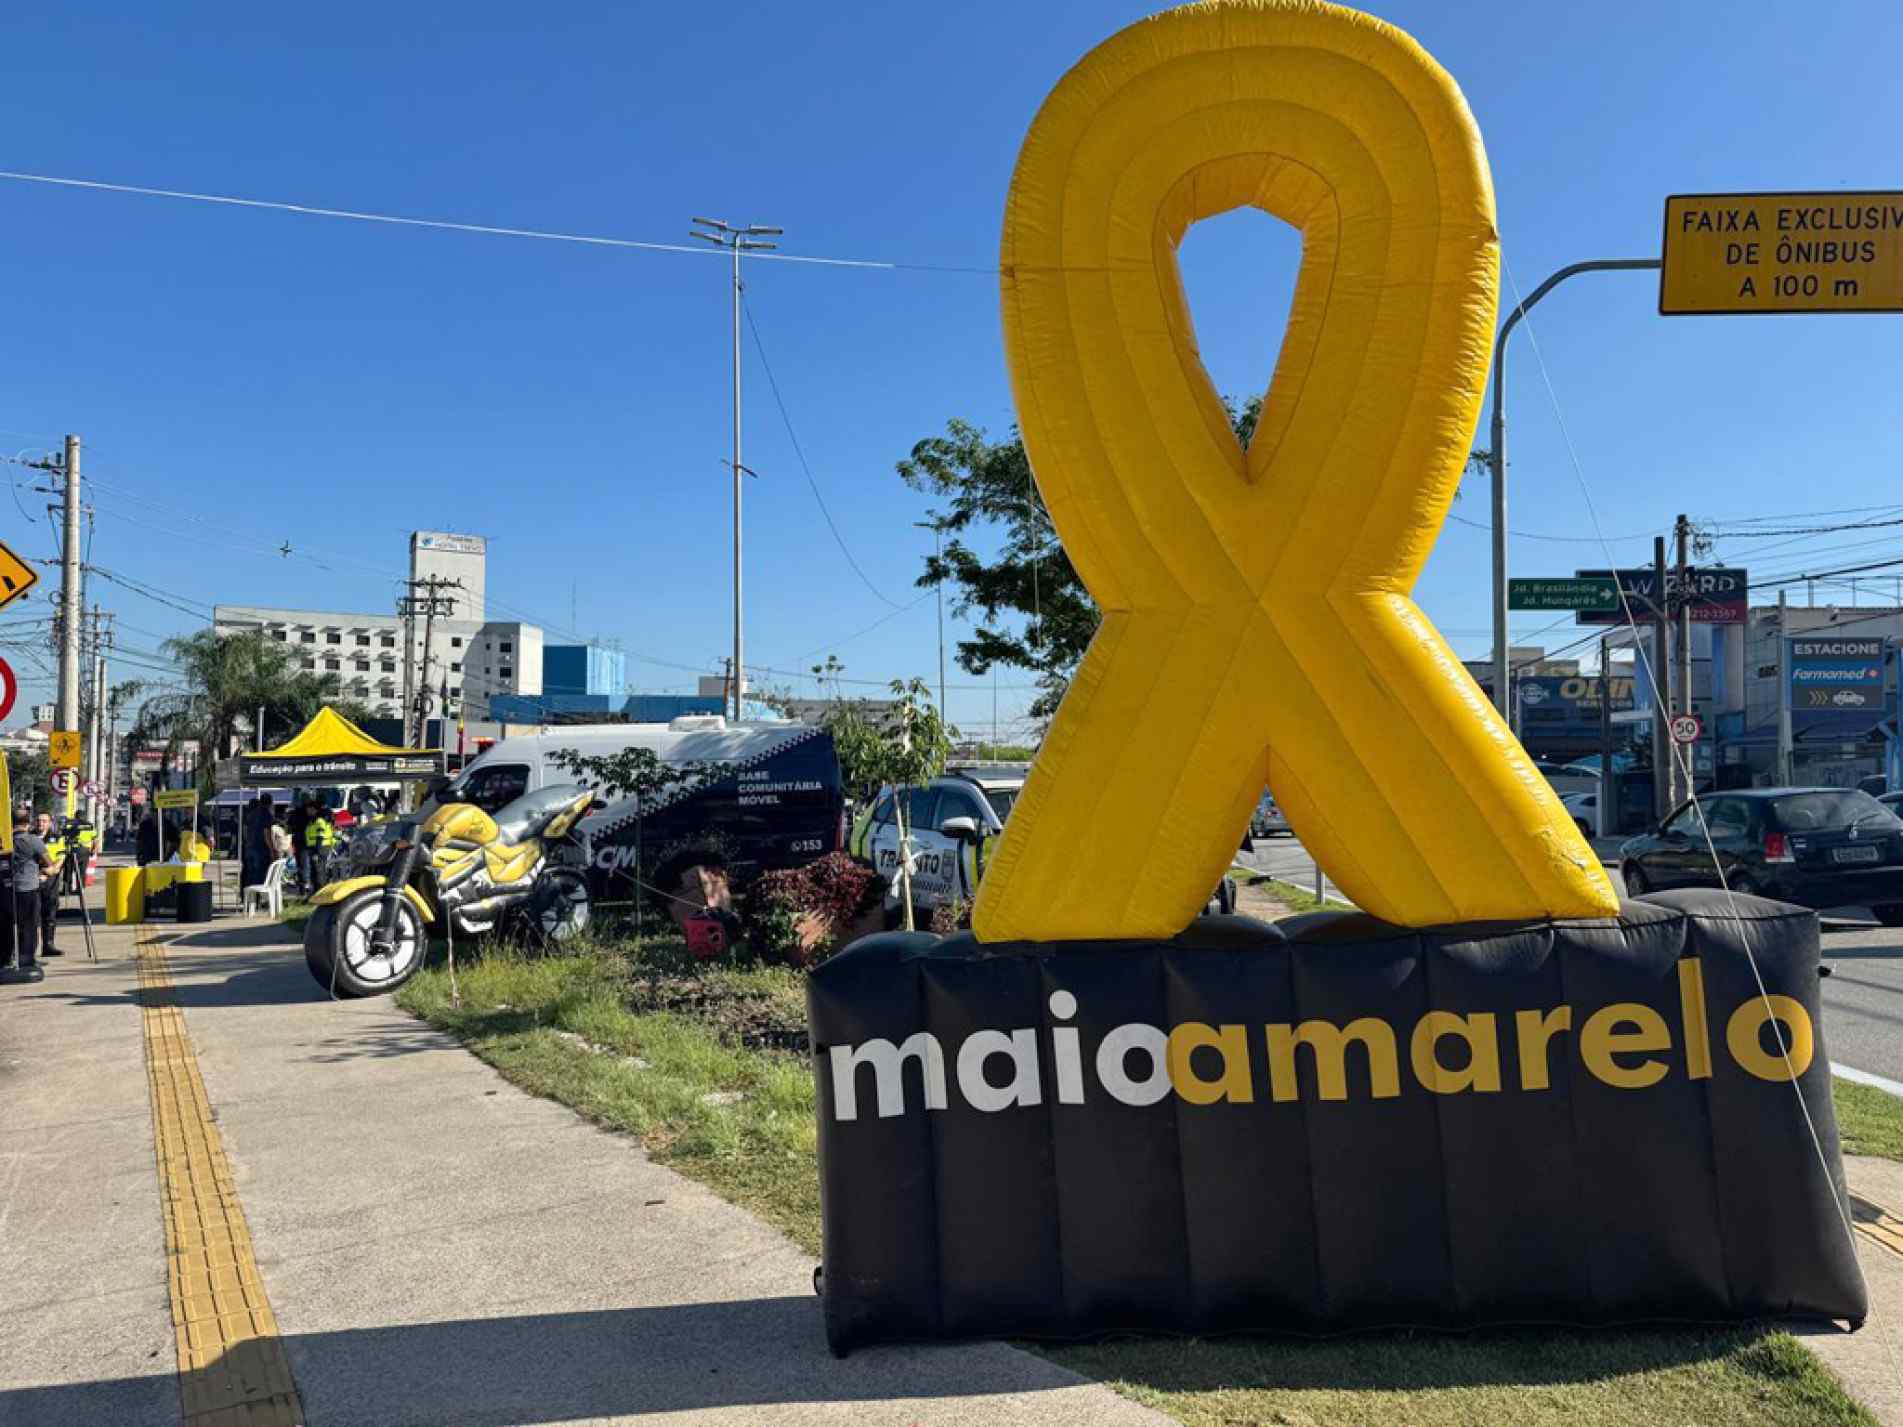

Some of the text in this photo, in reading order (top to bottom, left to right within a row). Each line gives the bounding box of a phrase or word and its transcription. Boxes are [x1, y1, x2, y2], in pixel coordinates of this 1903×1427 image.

[1682, 209, 1760, 232] FAIXA
[1726, 235, 1875, 264] DE ÔNIBUS
[1738, 275, 1858, 298] A 100 m
[1794, 643, 1880, 655] ESTACIONE
[1792, 668, 1866, 680] farmamed
[1676, 722, 1696, 735] 50
[737, 779, 824, 793] COMUNITÁRIA
[737, 793, 781, 805] MÓVEL
[802, 839, 823, 851] 153
